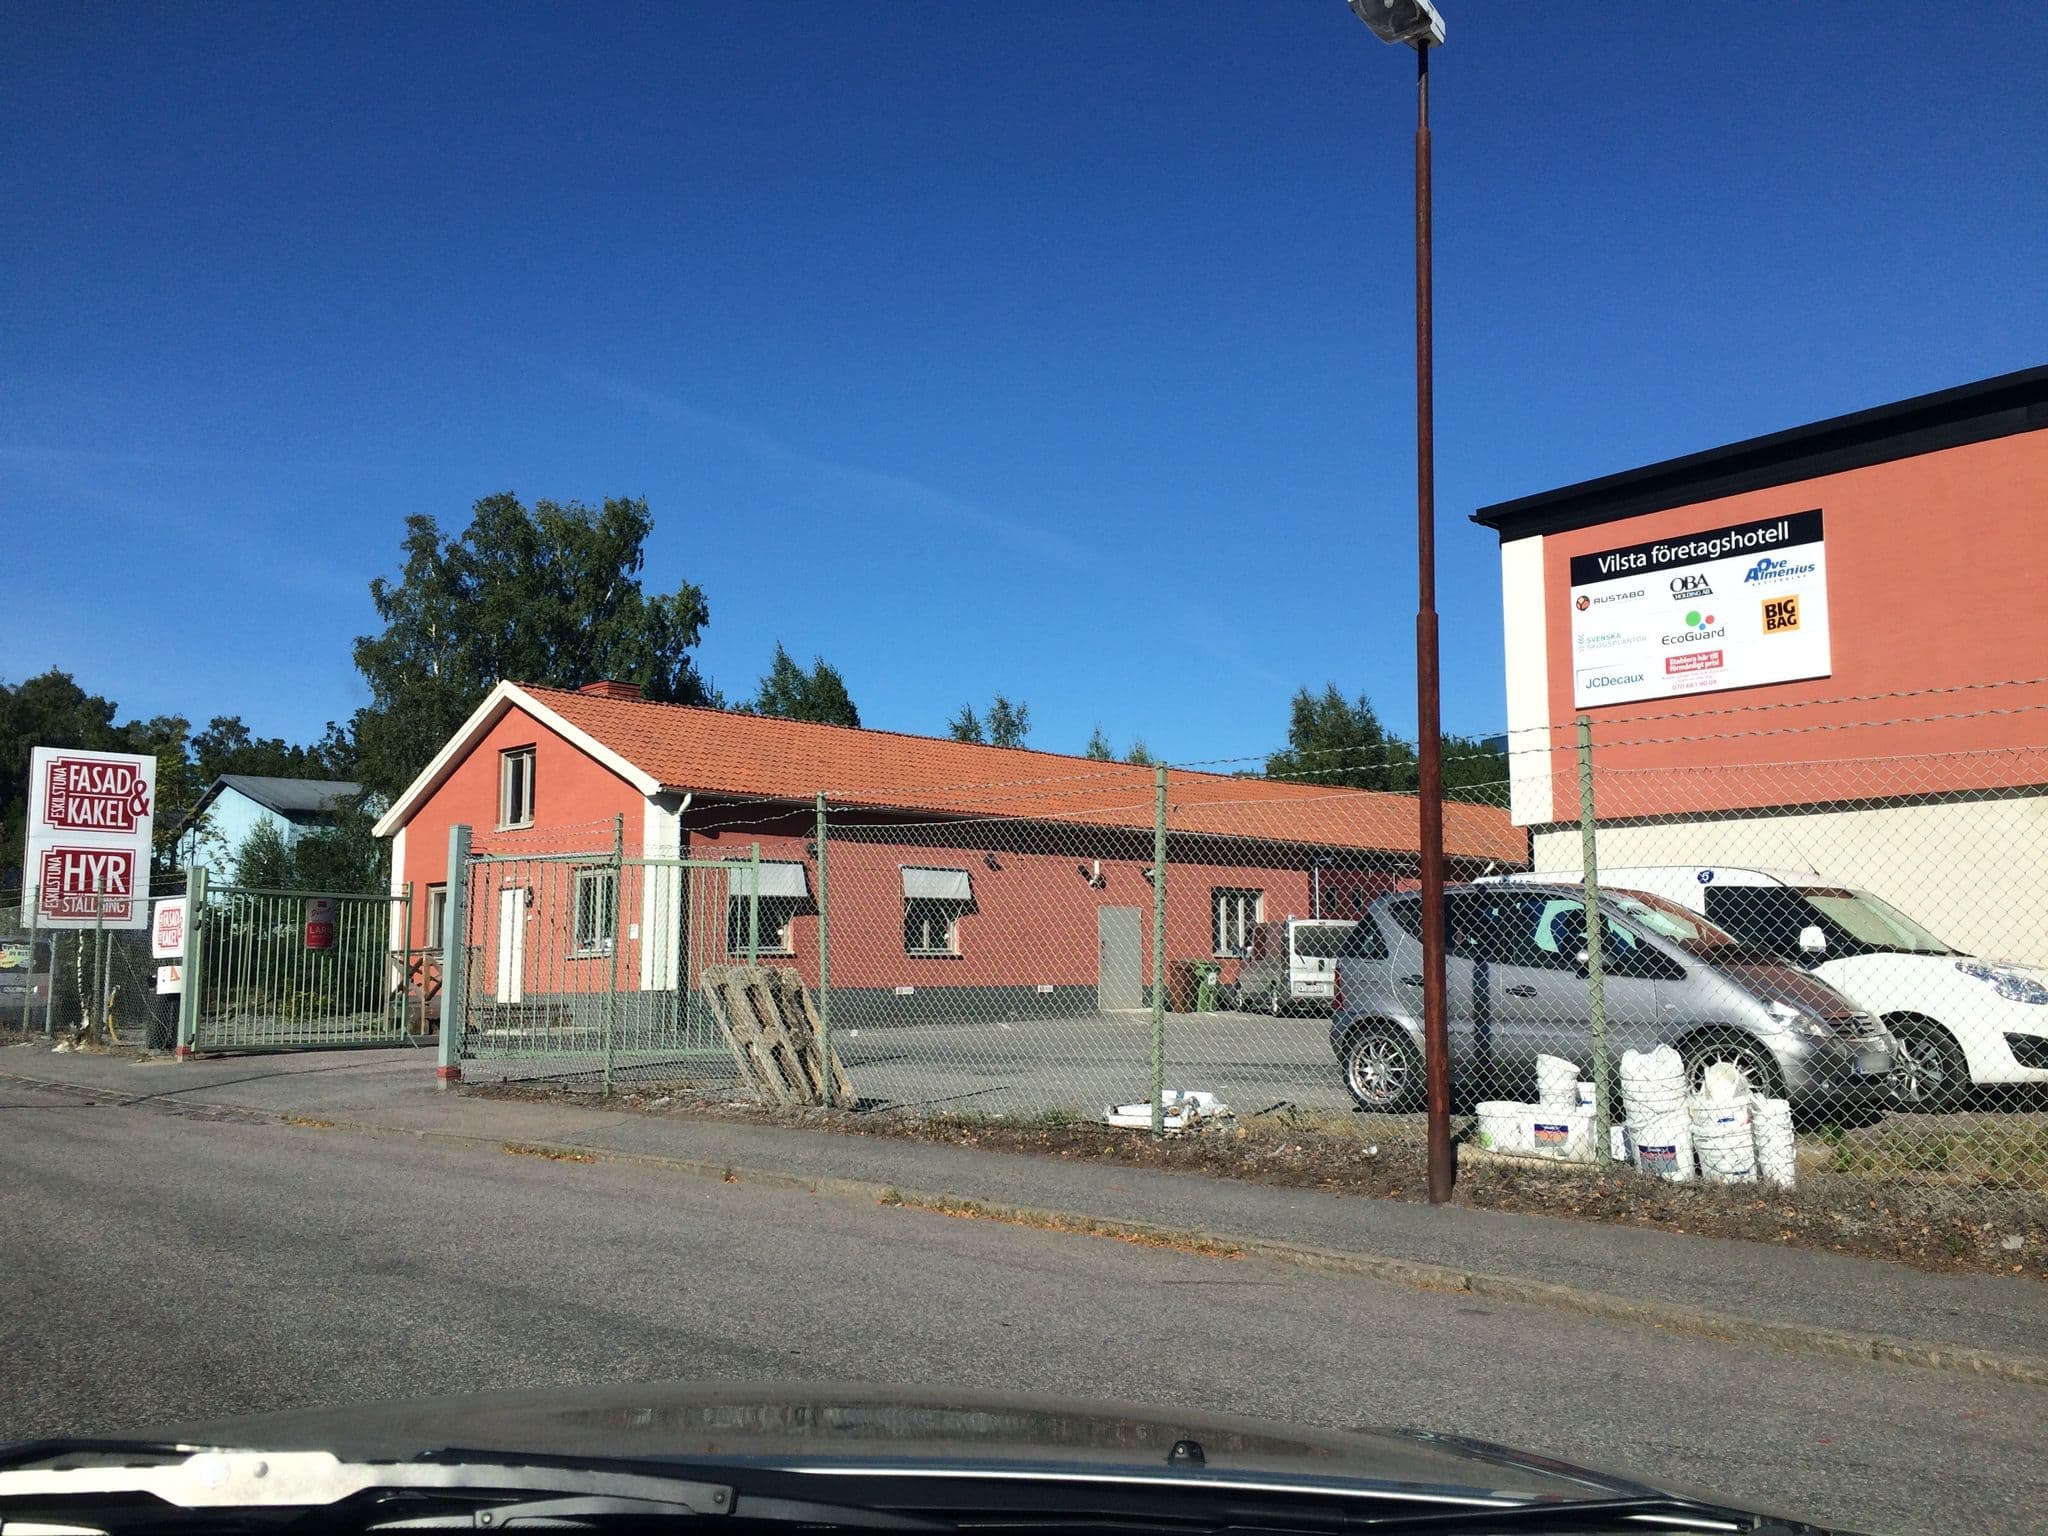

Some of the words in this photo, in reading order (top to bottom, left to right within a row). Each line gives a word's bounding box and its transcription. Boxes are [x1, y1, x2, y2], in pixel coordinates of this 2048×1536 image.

[1598, 552, 1647, 574] Vilsta
[1651, 521, 1790, 564] företagshotell
[1744, 563, 1816, 583] Almenius
[1757, 558, 1788, 572] Ove
[1670, 573, 1709, 592] OBA
[1593, 589, 1645, 605] RUSTABO
[1765, 599, 1796, 619] BIG
[1766, 614, 1797, 631] BAG
[1586, 632, 1622, 643] SVENSKA
[1661, 626, 1725, 646] EcoGuard
[1585, 674, 1645, 689] JCDecaux
[50, 767, 67, 818] ESKILSTUNA
[69, 765, 131, 794] FASAD
[129, 780, 150, 816] &
[67, 797, 128, 827] KAKEL
[45, 856, 62, 908] ESKILSTUNA
[63, 853, 126, 893] HYR
[62, 893, 125, 913] STÄLLING
